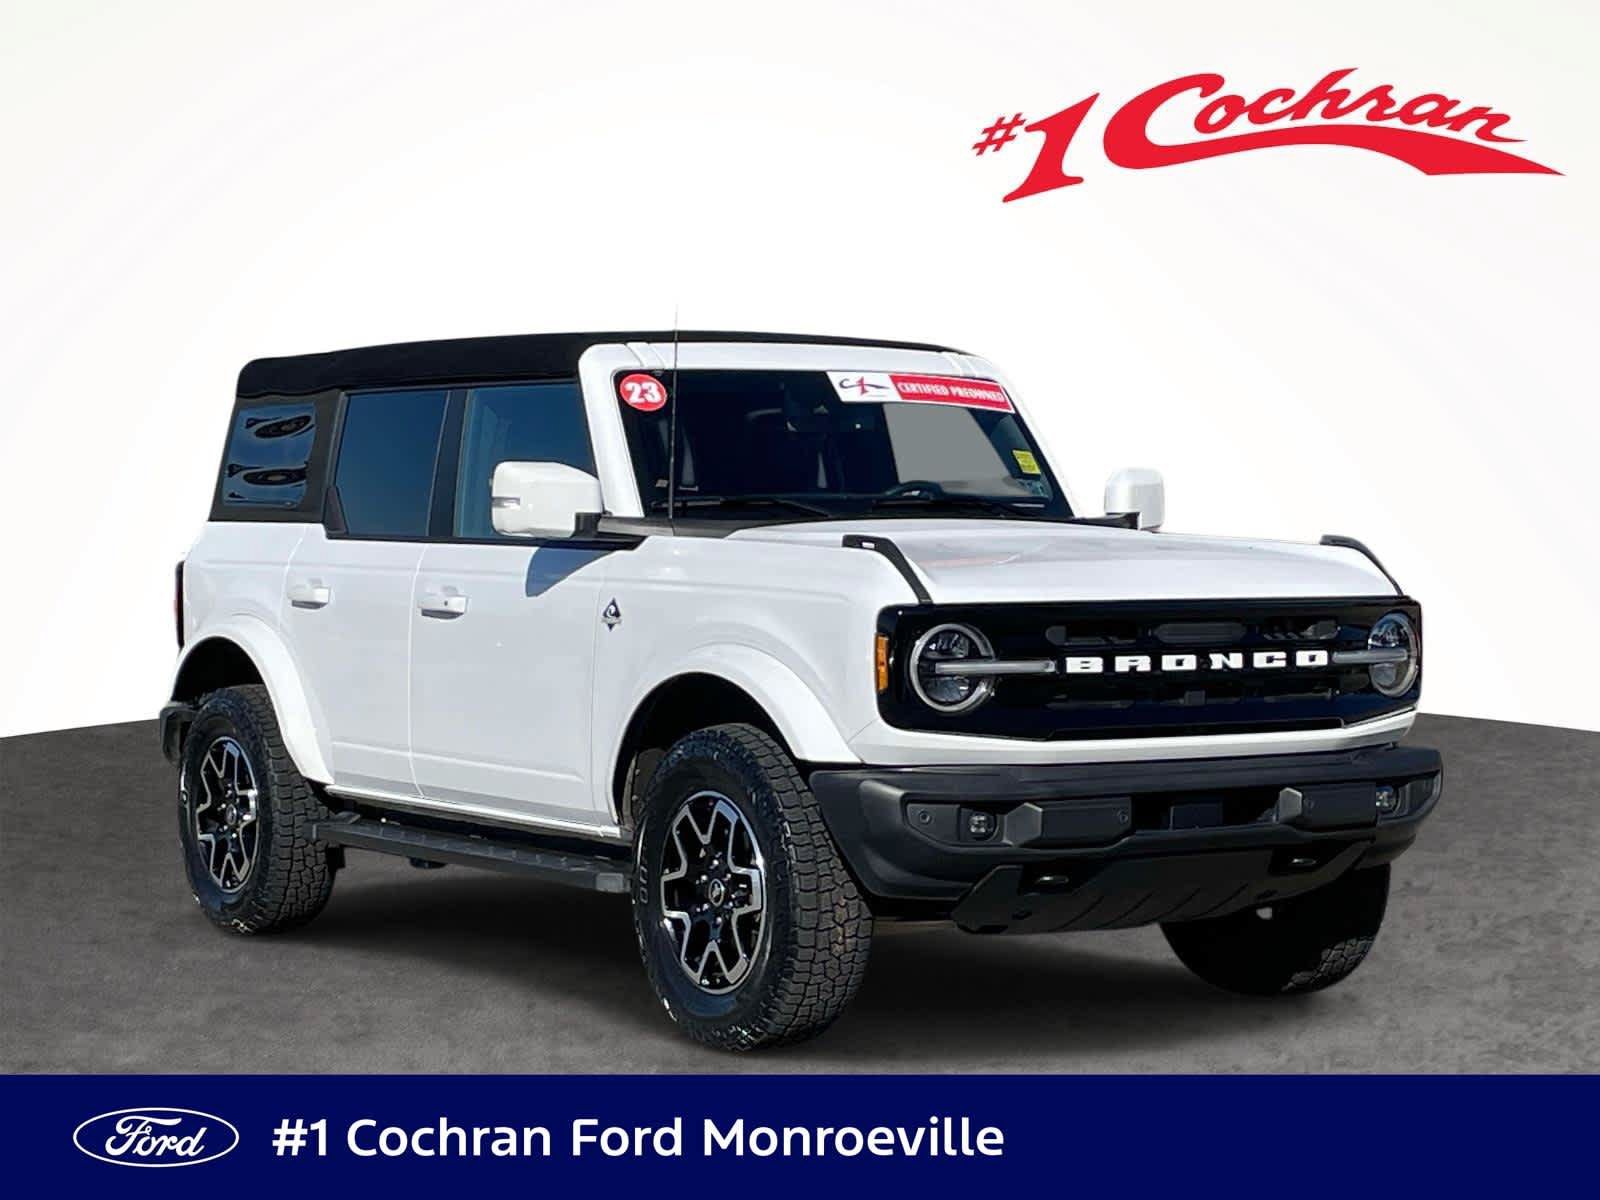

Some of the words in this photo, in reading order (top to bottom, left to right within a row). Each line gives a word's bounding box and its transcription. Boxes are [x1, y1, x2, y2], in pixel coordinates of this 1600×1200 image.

[624, 380, 663, 405] 23
[897, 382, 950, 396] CERTIFIED
[1065, 650, 1329, 674] BRONCO
